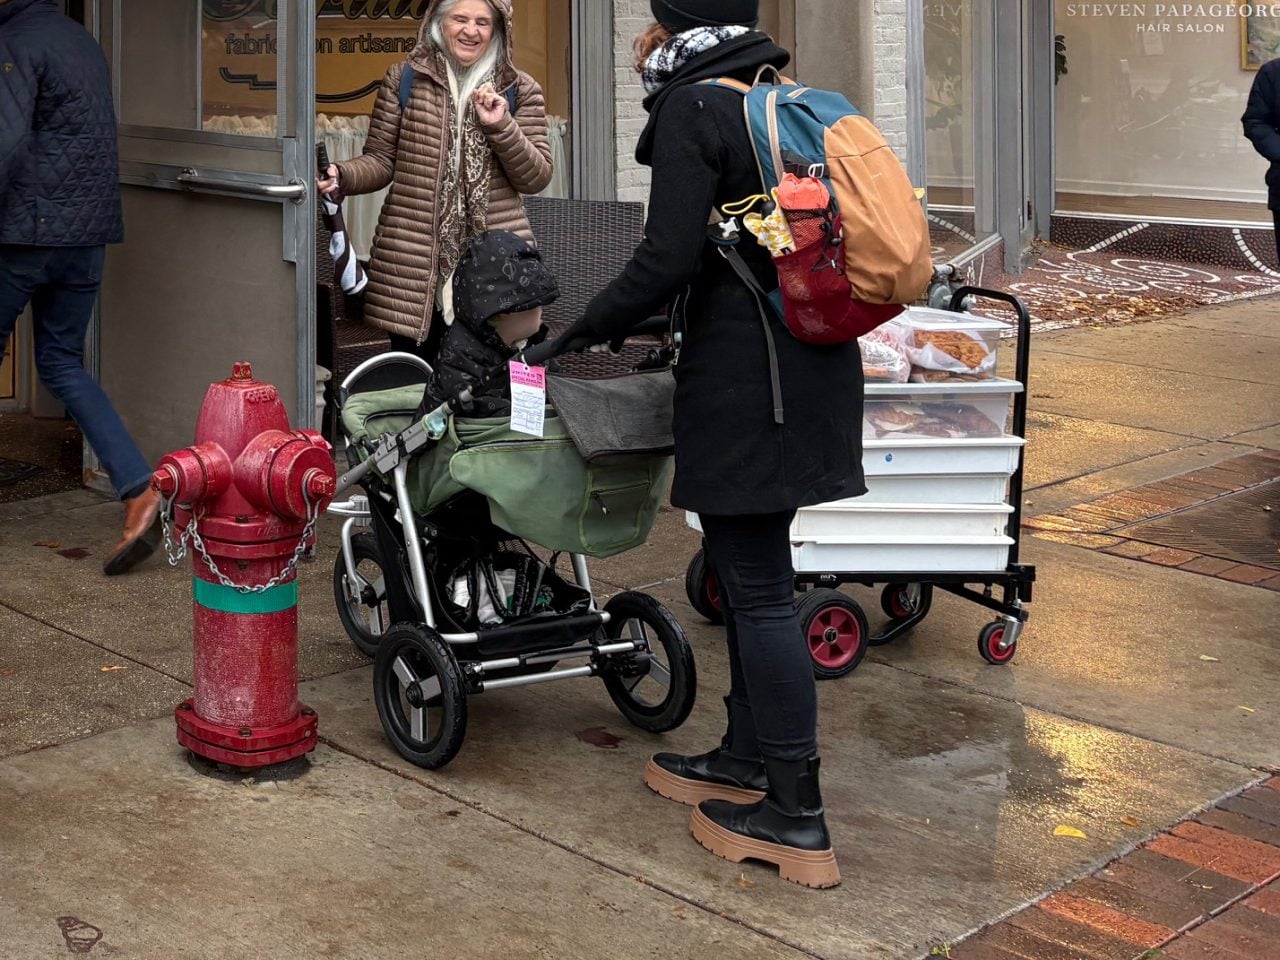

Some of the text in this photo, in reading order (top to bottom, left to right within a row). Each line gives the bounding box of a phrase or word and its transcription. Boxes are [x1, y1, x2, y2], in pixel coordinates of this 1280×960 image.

[1066, 4, 1146, 17] STEVEN
[1136, 24, 1225, 33] HAIR SALON
